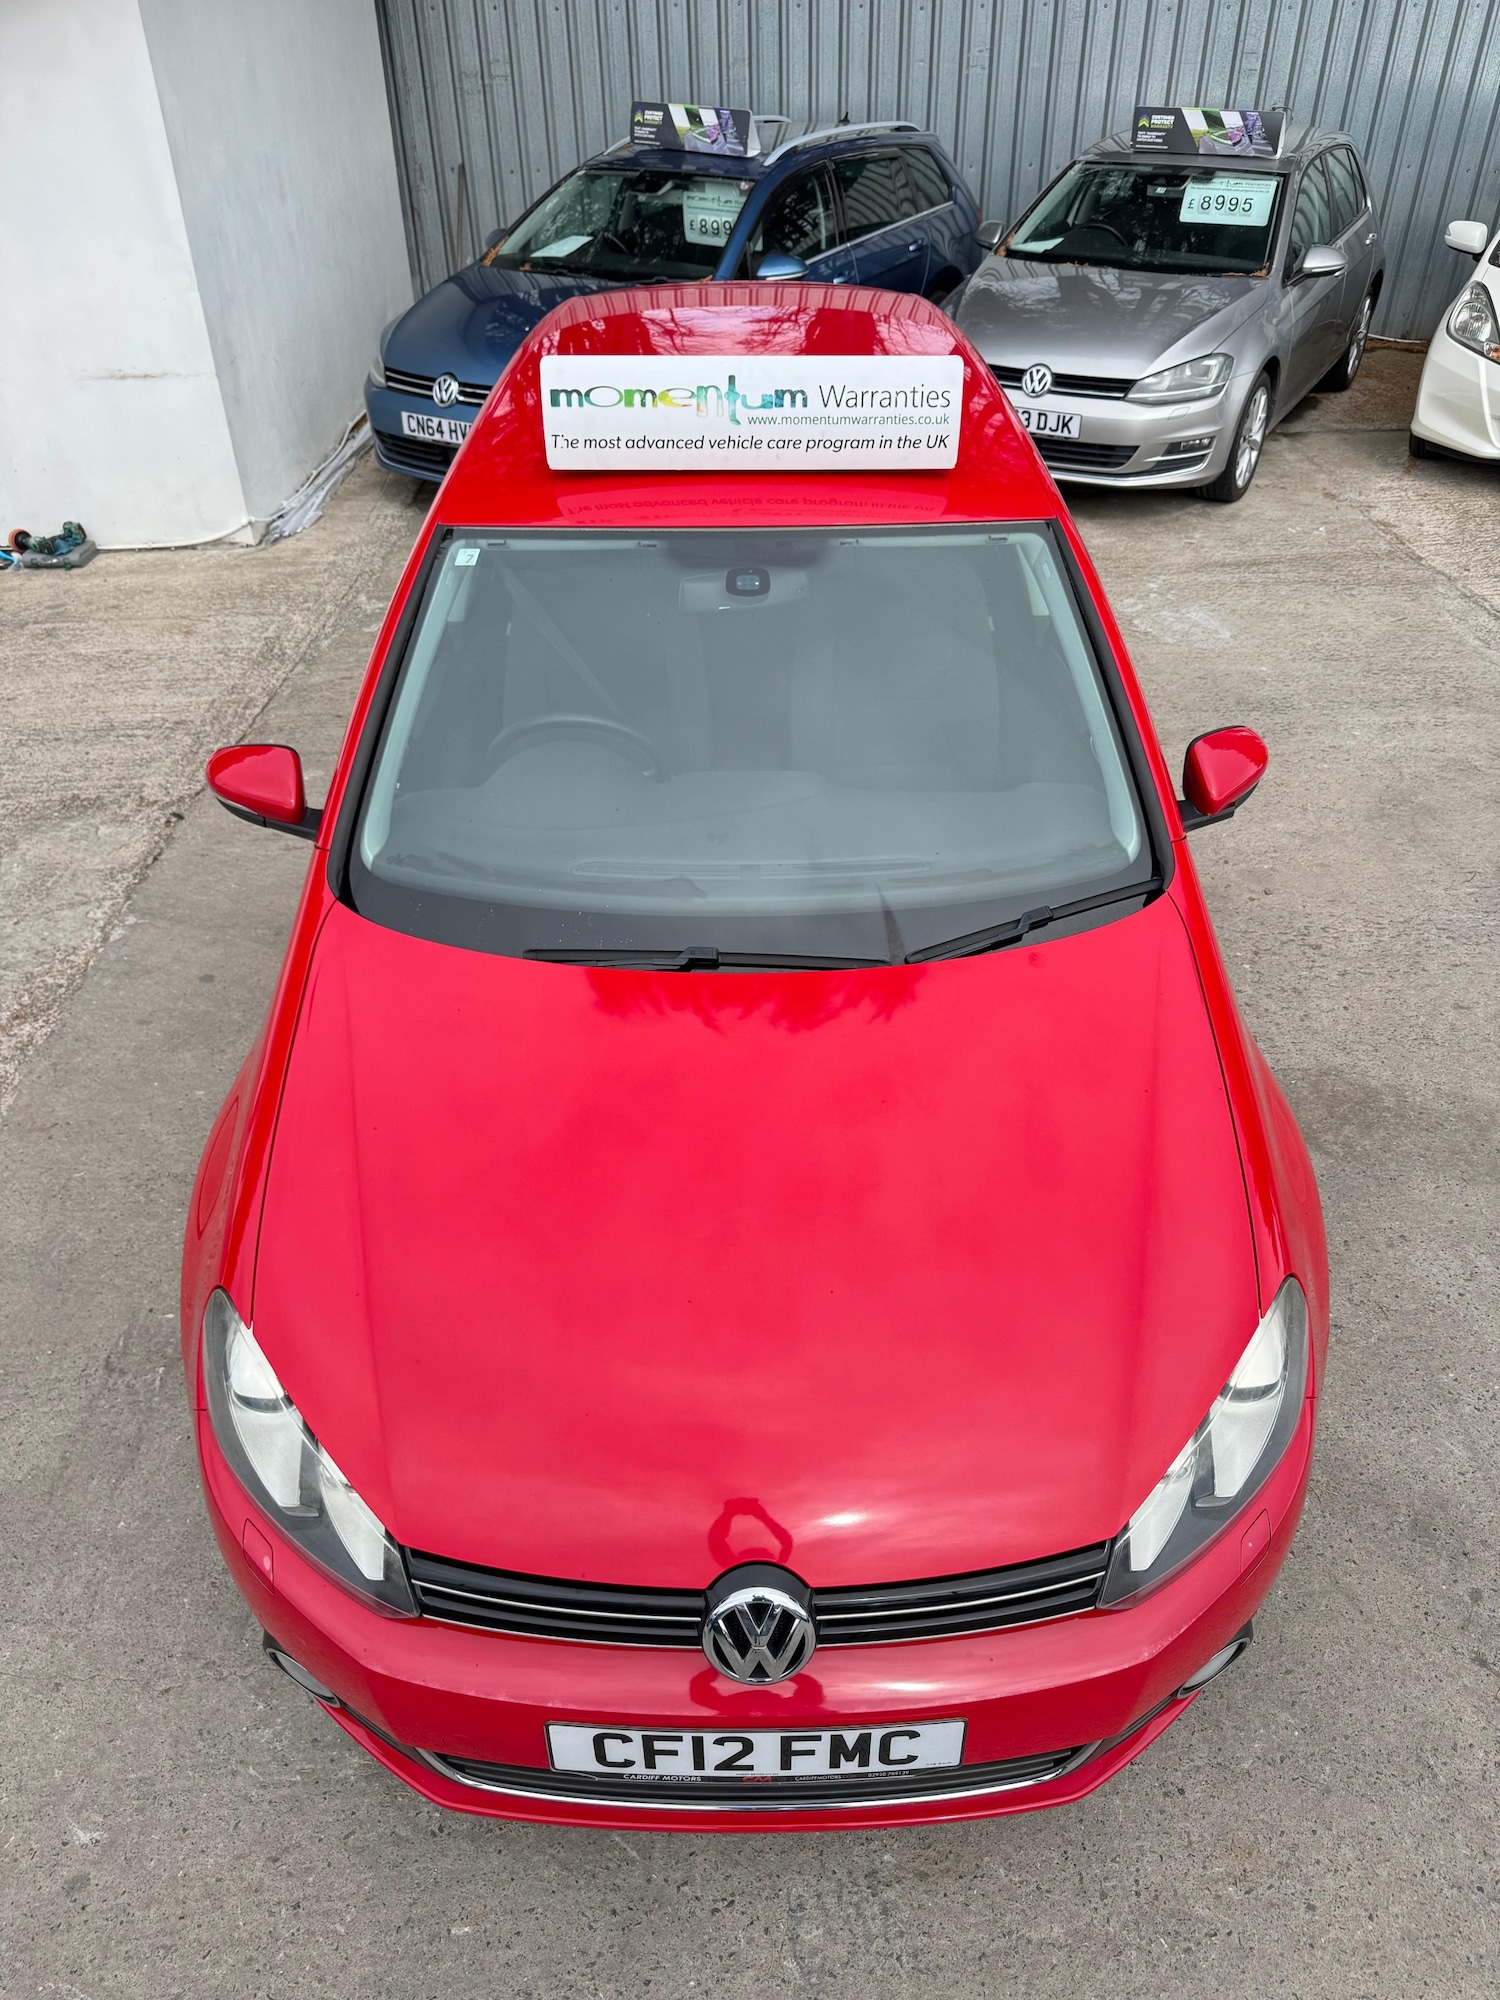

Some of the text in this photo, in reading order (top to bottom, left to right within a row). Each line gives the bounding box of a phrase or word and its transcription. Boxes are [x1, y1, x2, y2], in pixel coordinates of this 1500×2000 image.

[1200, 194, 1254, 213] 8995
[550, 375, 951, 425] momentum Warranties
[407, 415, 472, 442] CN64 HV
[747, 413, 950, 426] www.momentumwarranties.co.uk
[1016, 409, 1074, 434] 3 DJK
[583, 434, 622, 449] most
[625, 434, 704, 449] advanced
[708, 434, 763, 449] vehicle
[767, 438, 802, 449] care
[806, 434, 875, 453] program
[879, 434, 893, 449] in
[897, 434, 922, 449] the
[926, 434, 950, 449] UK
[592, 1730, 921, 1771] CF12 FMC
